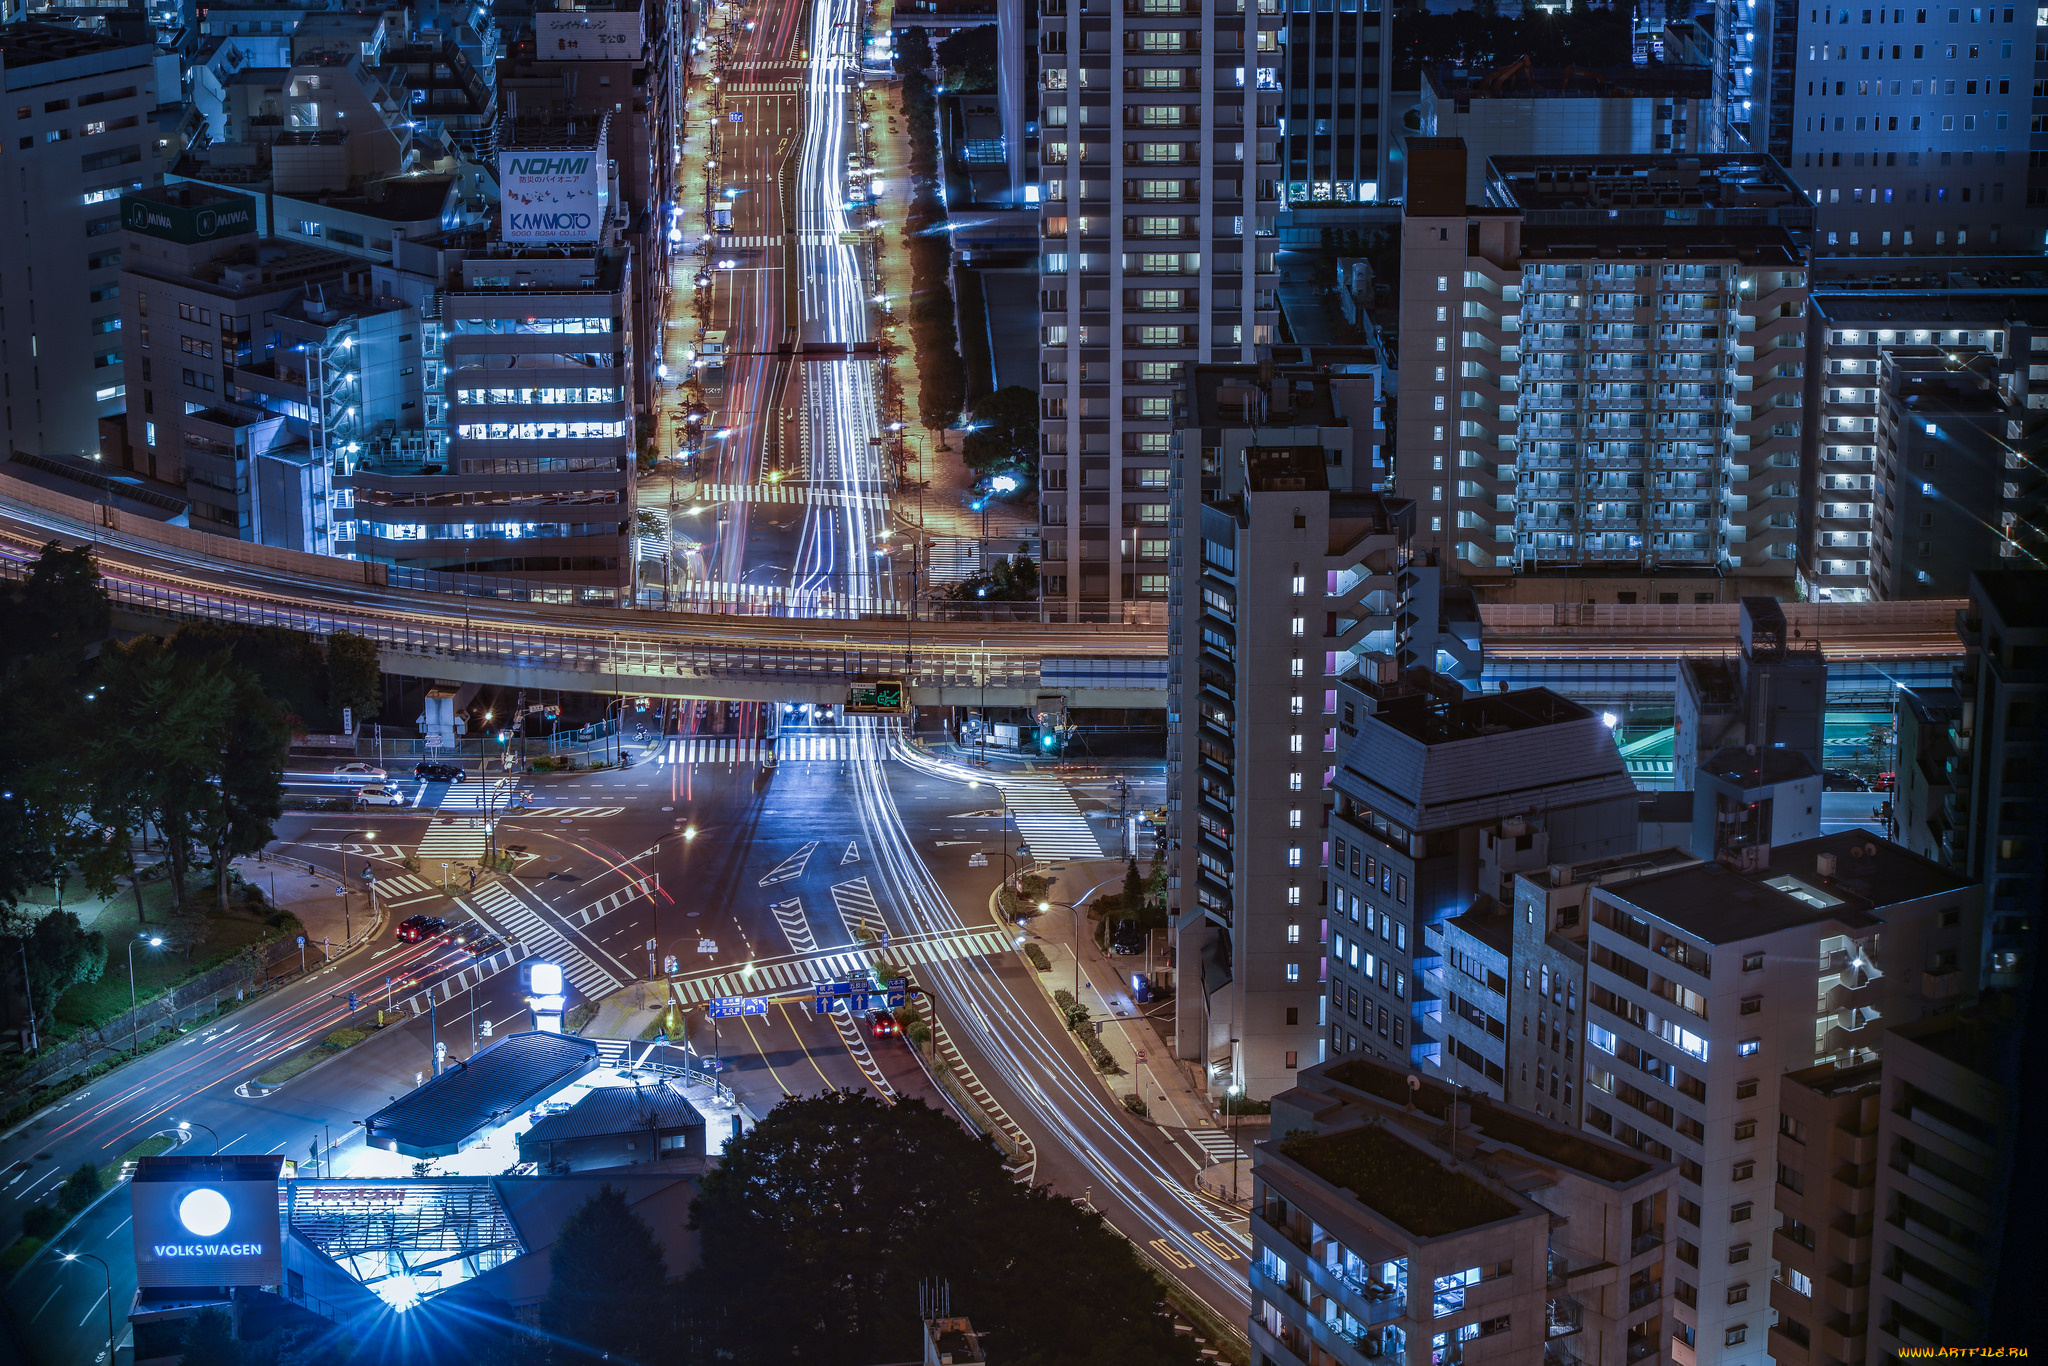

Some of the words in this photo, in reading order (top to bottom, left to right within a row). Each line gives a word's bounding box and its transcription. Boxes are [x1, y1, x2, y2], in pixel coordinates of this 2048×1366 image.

[598, 34, 626, 44] 芝公園
[509, 158, 589, 175] NOHMI
[148, 212, 172, 229] MIWA
[217, 210, 248, 227] MIWA
[312, 1188, 406, 1201] Iwatani
[155, 1244, 262, 1256] VOLKSWAGEN
[1149, 1239, 1195, 1269] 50
[1192, 1231, 1240, 1260] 50
